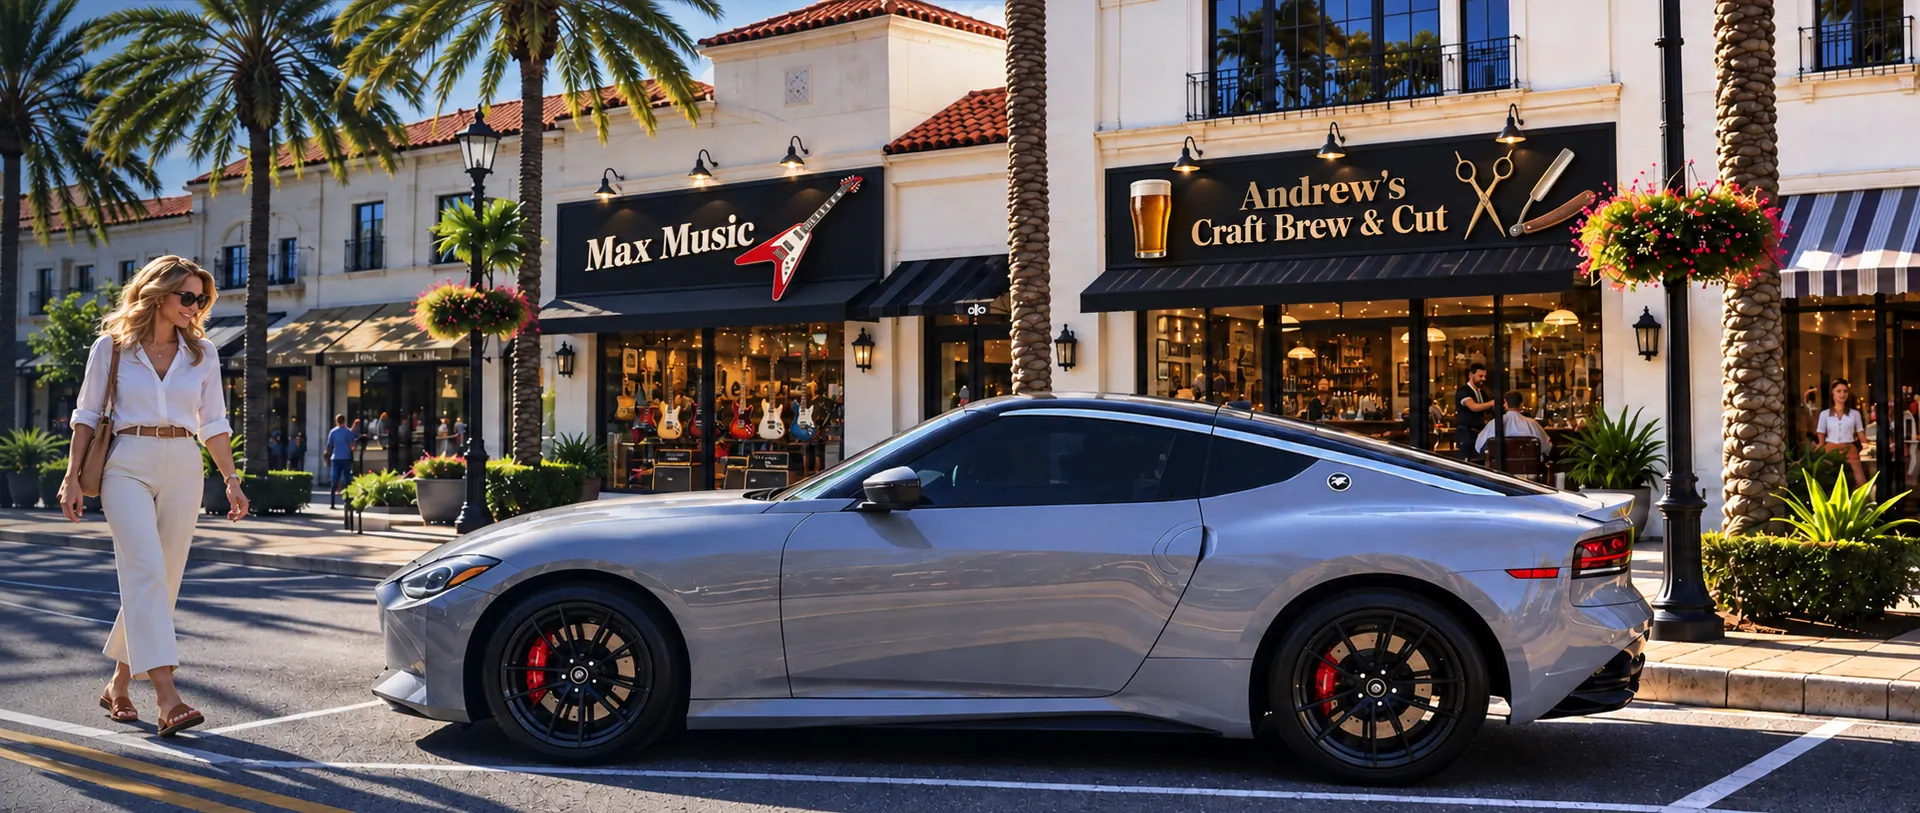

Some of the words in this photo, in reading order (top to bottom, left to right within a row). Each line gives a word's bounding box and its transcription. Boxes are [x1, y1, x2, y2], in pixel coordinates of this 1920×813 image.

[1240, 170, 1406, 211] Andrew's
[585, 234, 653, 272] Max
[660, 214, 756, 260] Music
[1192, 215, 1266, 246] Craft
[1274, 213, 1353, 242] Brew
[1361, 208, 1385, 236] &
[1392, 204, 1449, 234] Cut
